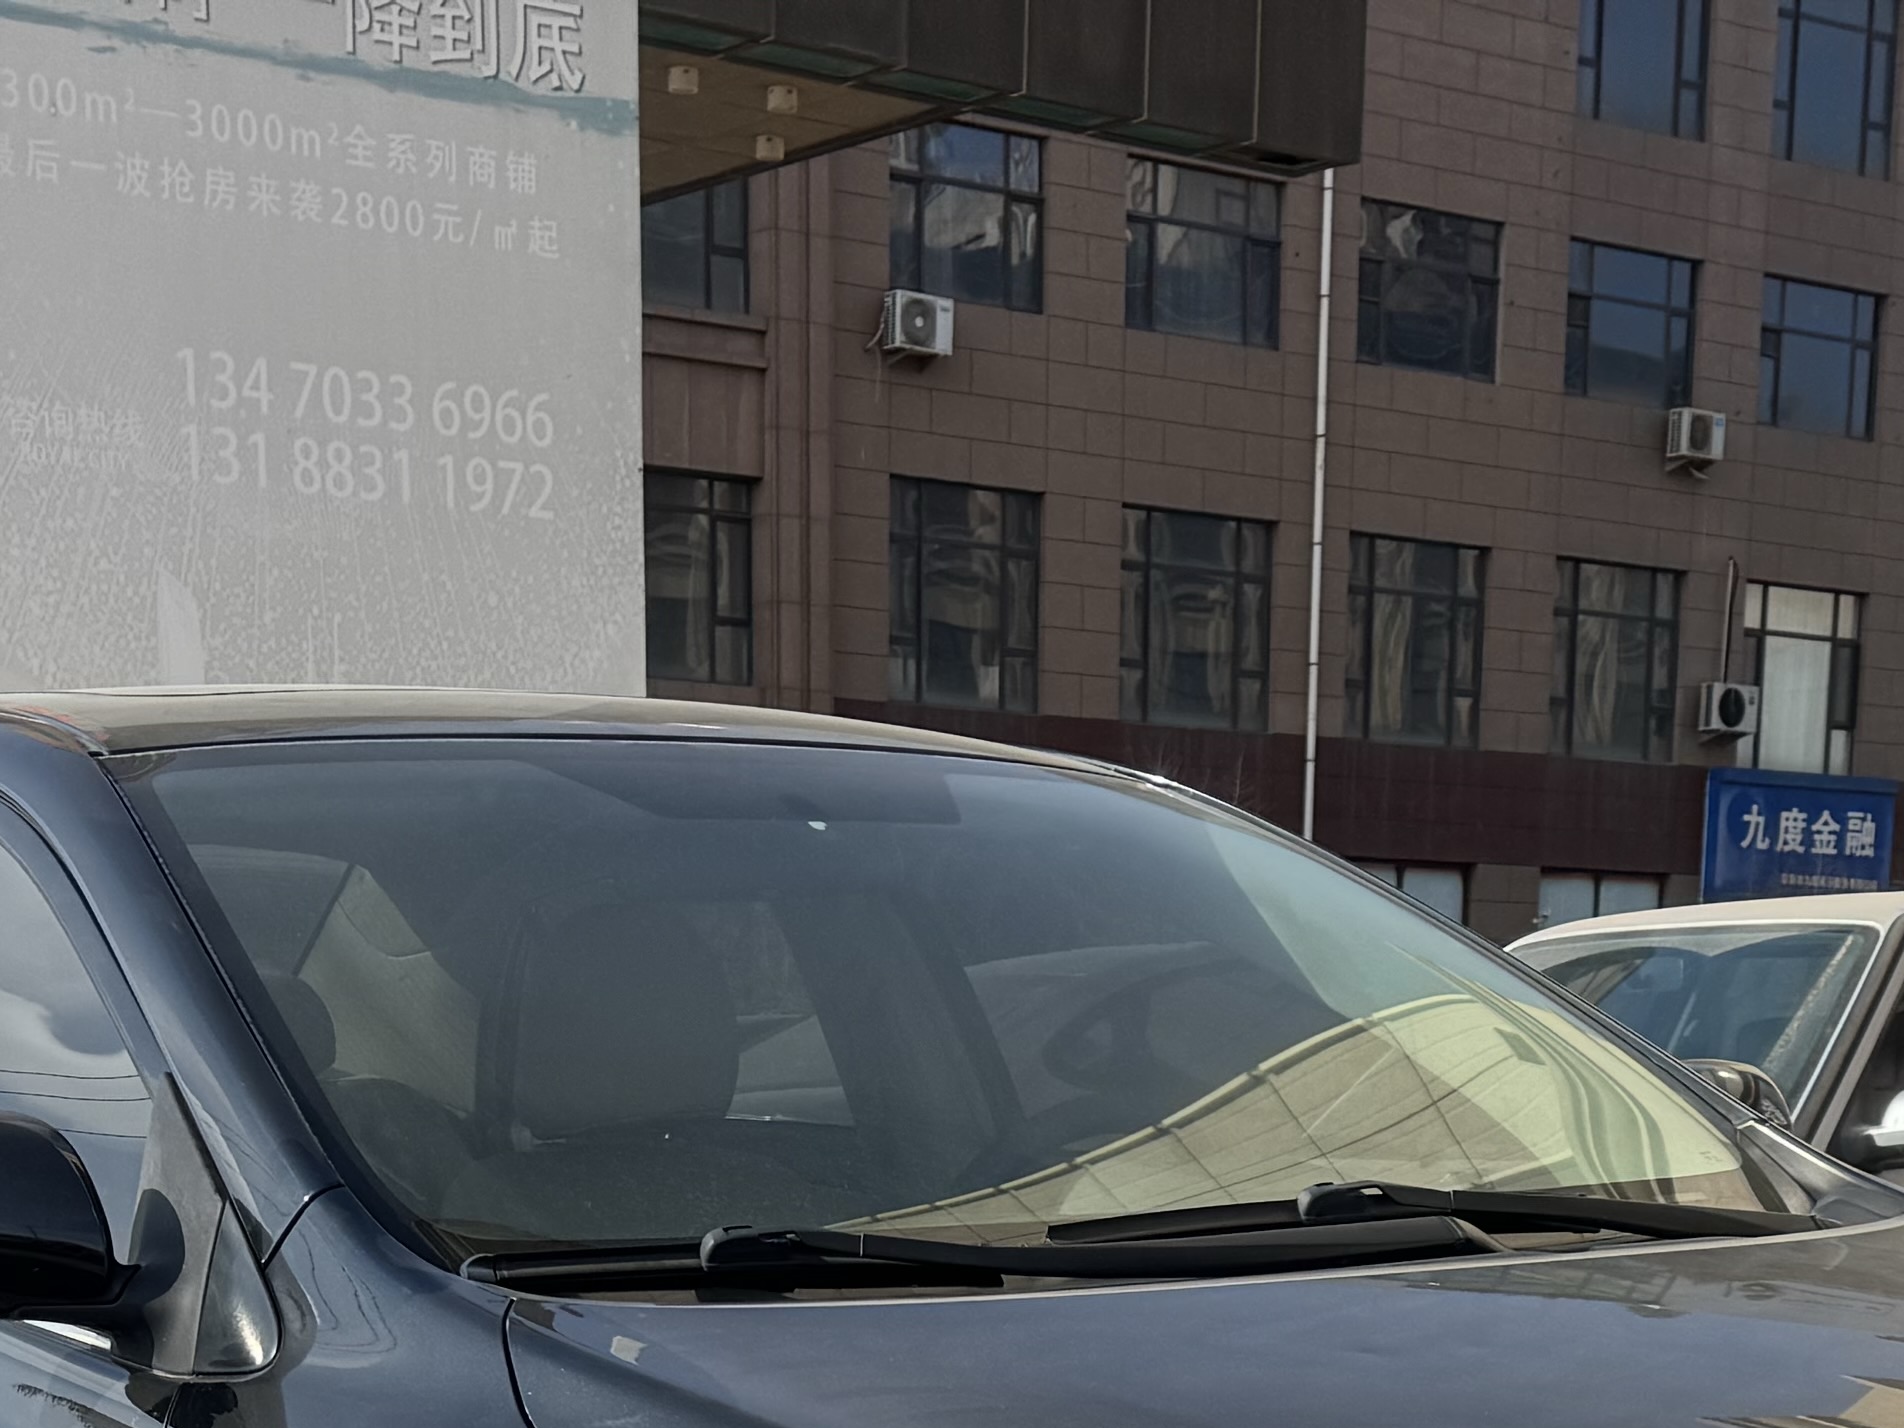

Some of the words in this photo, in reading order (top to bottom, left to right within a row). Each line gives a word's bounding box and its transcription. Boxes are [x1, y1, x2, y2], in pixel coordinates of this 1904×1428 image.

[176, 347, 273, 416] 134
[289, 361, 415, 433] 7033
[432, 380, 554, 448] 6966
[181, 425, 269, 490] 131
[293, 437, 412, 503] 8831
[438, 453, 555, 521] 1972
[1740, 803, 1876, 859] 九度金融
